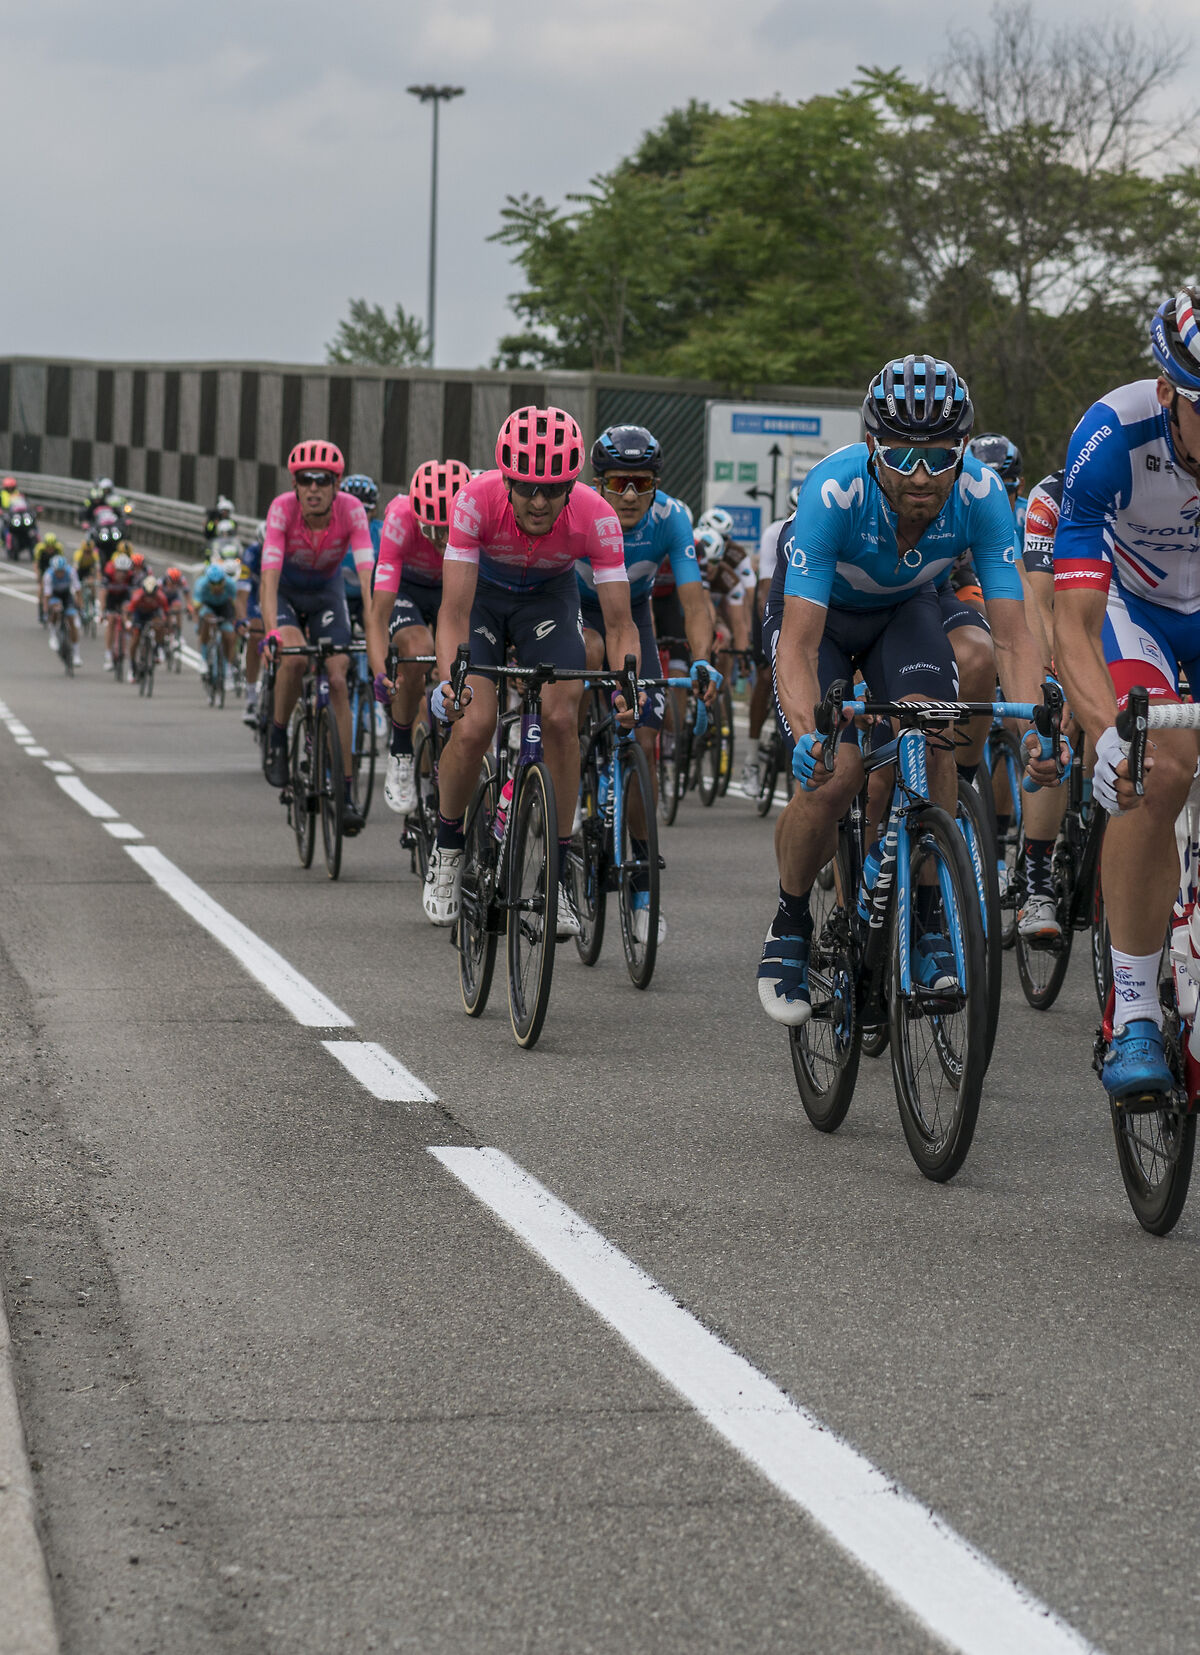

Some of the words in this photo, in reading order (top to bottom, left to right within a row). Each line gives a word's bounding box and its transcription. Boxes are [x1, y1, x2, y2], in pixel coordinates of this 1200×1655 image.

[1065, 424, 1113, 489] Groupama
[1026, 541, 1055, 552] NIPP
[1054, 570, 1106, 581] PIERRE
[906, 738, 918, 793] CANYON
[868, 805, 900, 929] CANYON
